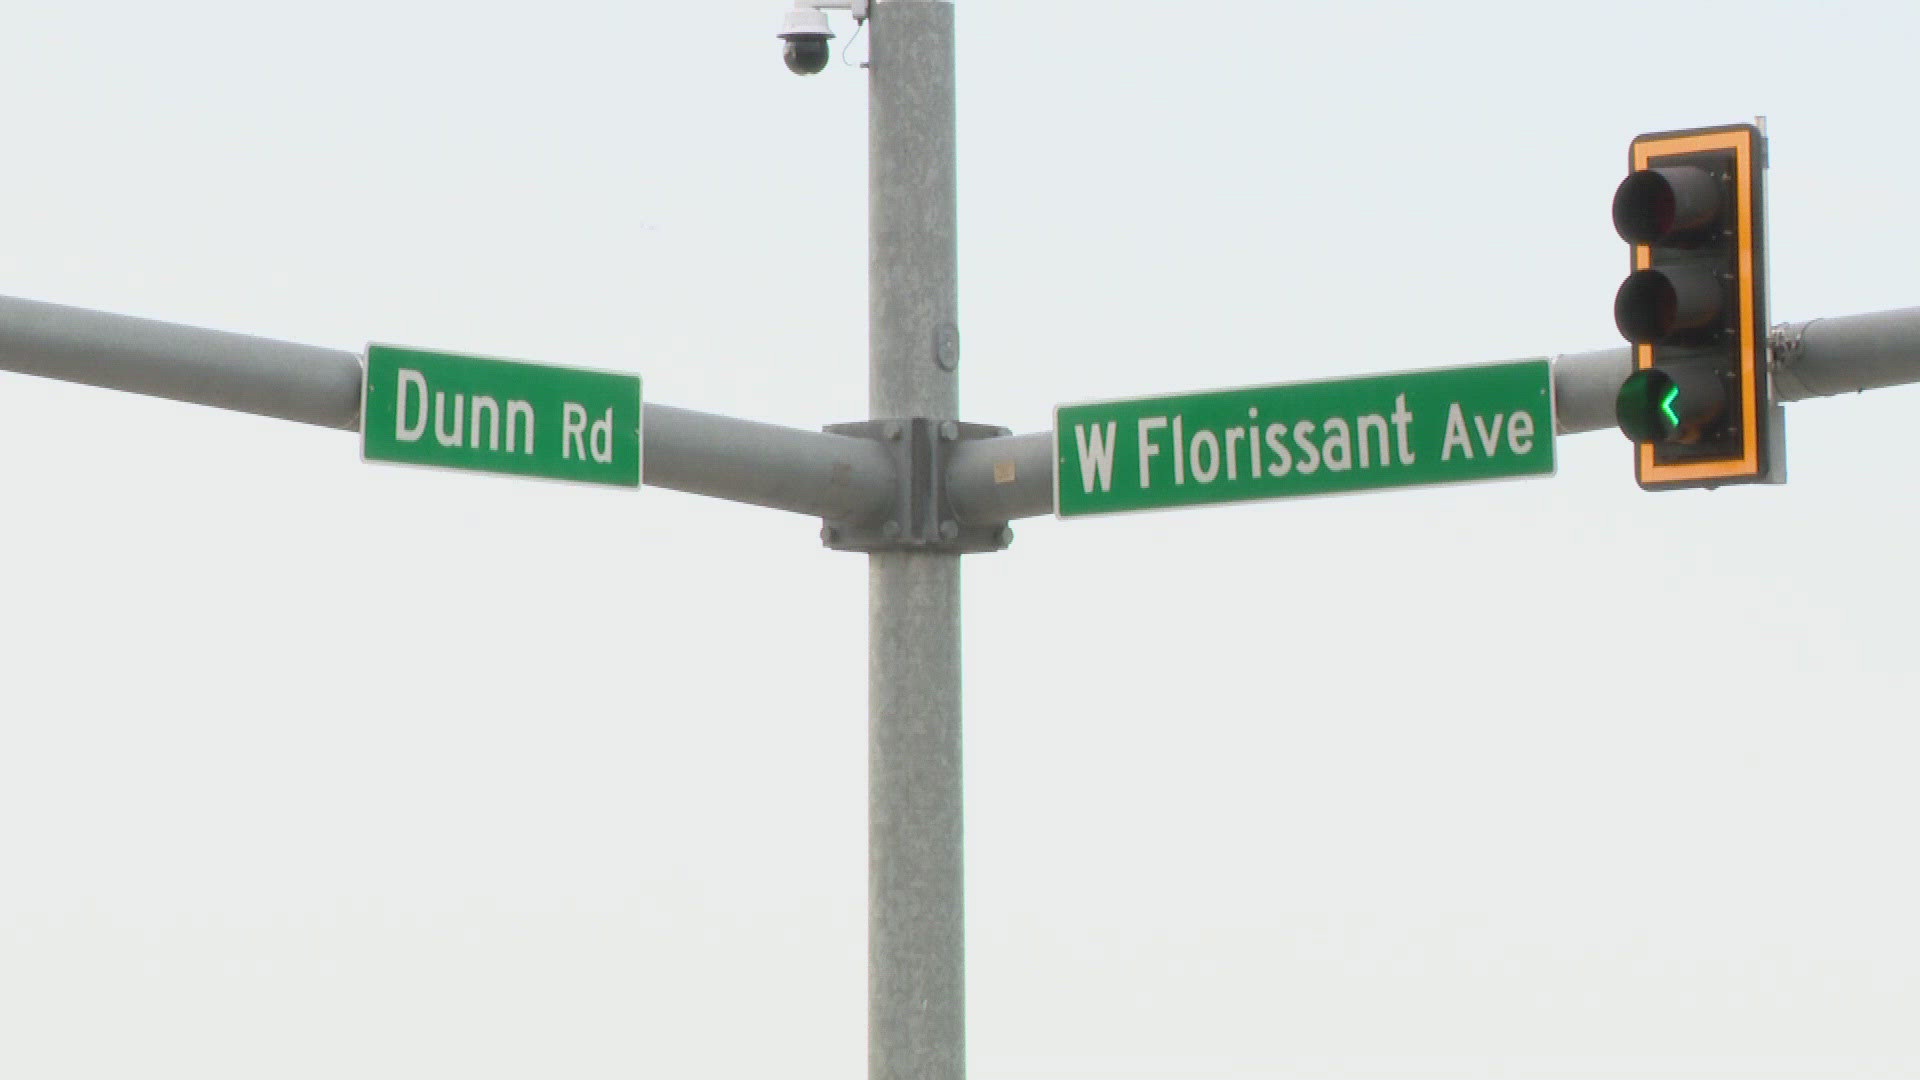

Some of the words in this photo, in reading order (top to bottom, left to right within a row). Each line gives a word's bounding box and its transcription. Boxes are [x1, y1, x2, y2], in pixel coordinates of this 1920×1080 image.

[395, 368, 535, 455] Dunn
[562, 401, 613, 463] Rd
[1074, 421, 1117, 493] W
[1138, 393, 1415, 489] Florissant
[1441, 403, 1535, 461] Ave
